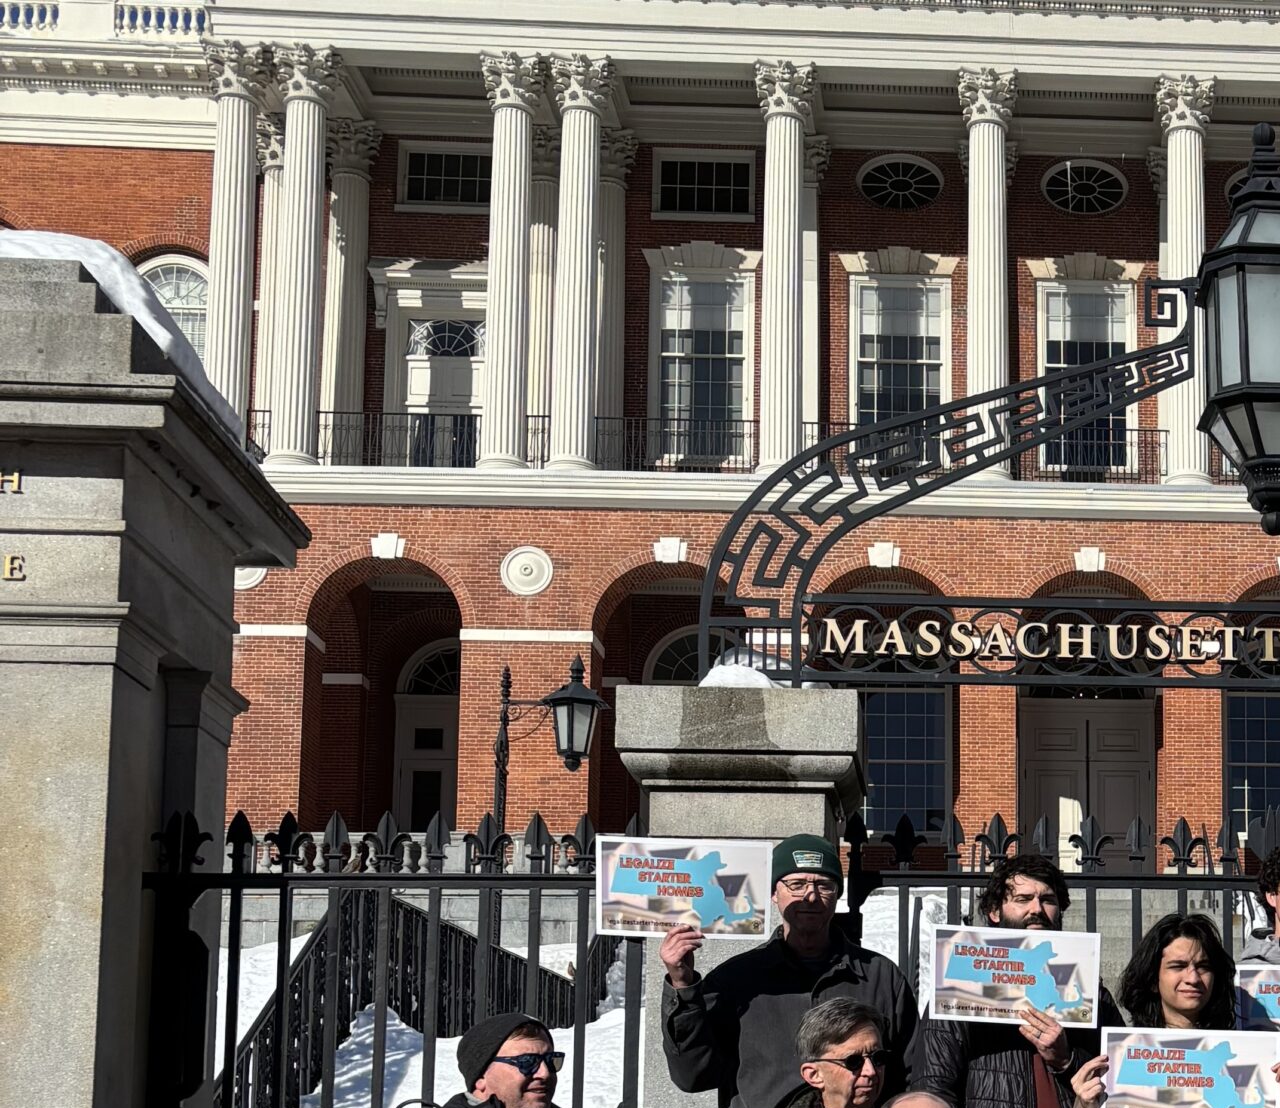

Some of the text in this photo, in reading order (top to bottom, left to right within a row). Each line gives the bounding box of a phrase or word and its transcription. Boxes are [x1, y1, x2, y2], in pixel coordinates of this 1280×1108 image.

[2, 553, 27, 581] E
[619, 857, 675, 870] LEGALIZE
[638, 872, 692, 884] STARTER
[657, 886, 704, 897] HOMES
[954, 945, 1009, 958] LEGALIZE
[973, 959, 1024, 972] STARTER
[992, 973, 1036, 985] HOMES
[1127, 1048, 1185, 1060] LEGALIZE
[1147, 1062, 1202, 1074] STARTER
[1167, 1076, 1214, 1088] HOMES
